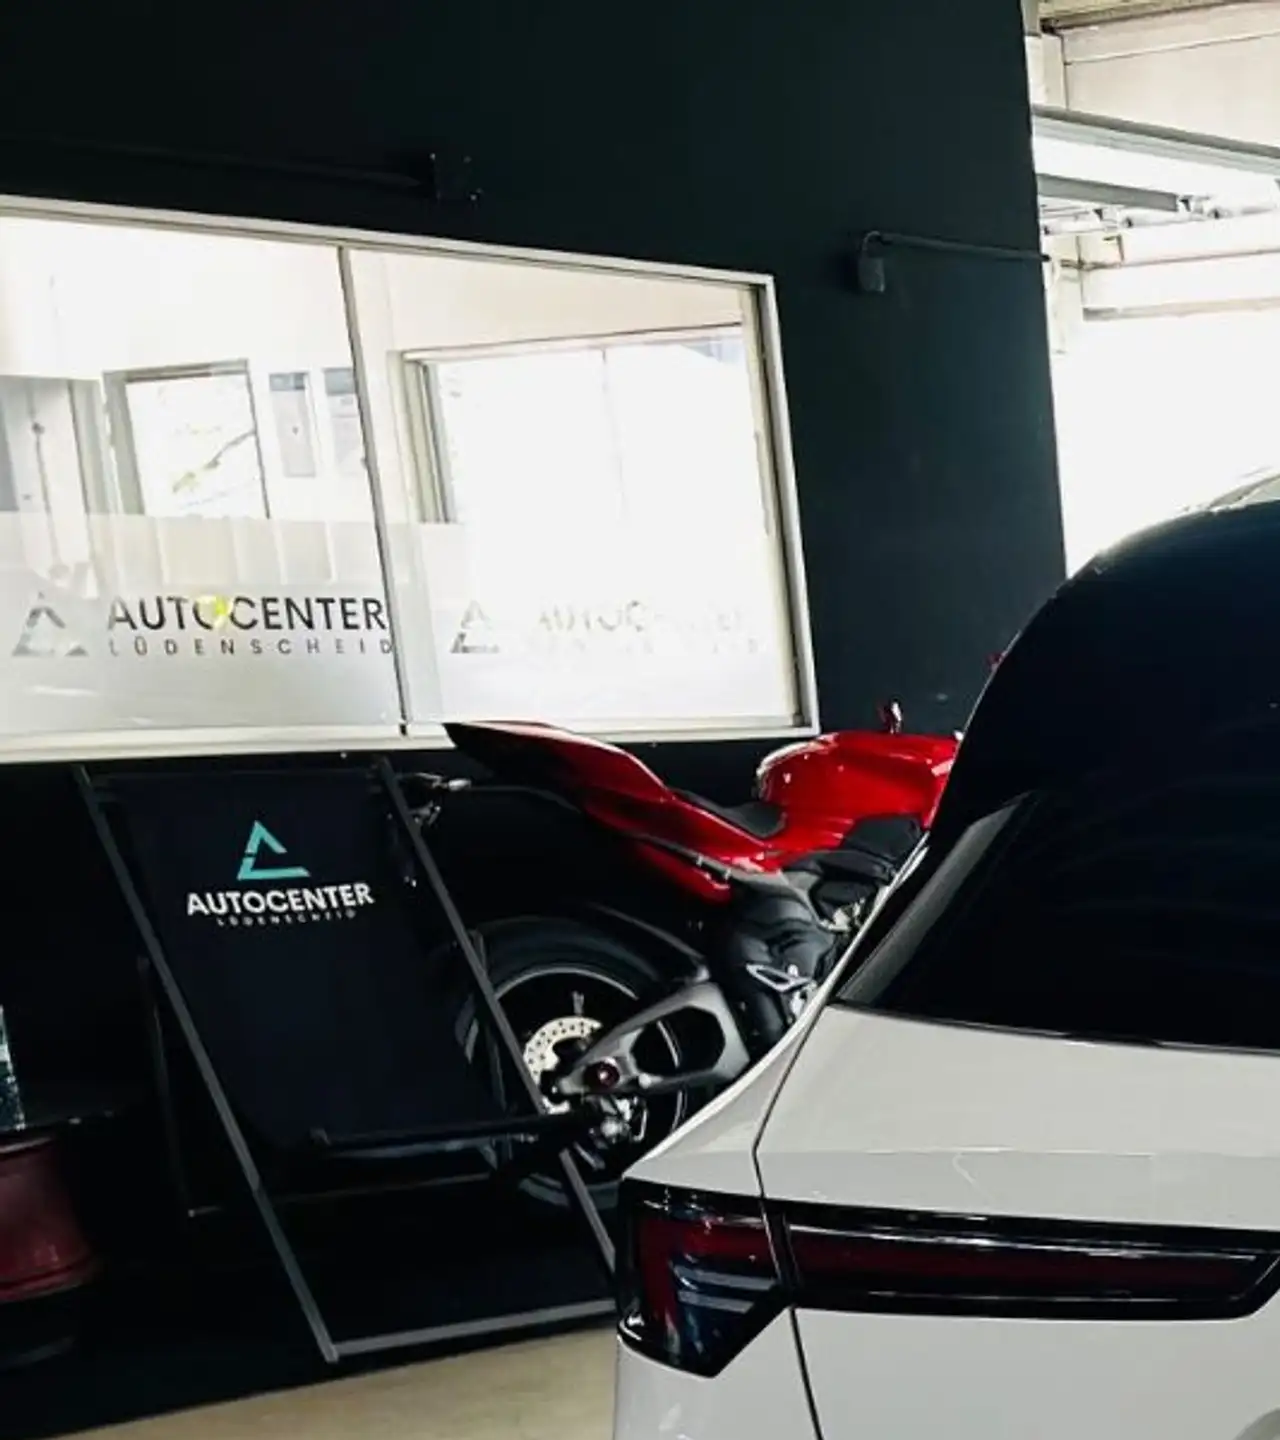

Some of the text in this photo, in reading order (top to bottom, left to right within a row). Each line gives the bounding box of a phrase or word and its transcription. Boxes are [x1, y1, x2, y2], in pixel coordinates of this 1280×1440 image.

[107, 596, 388, 632] AUTOCENTER
[108, 636, 393, 657] LÜDENSCHEID
[187, 882, 375, 917] AUTOCENTER
